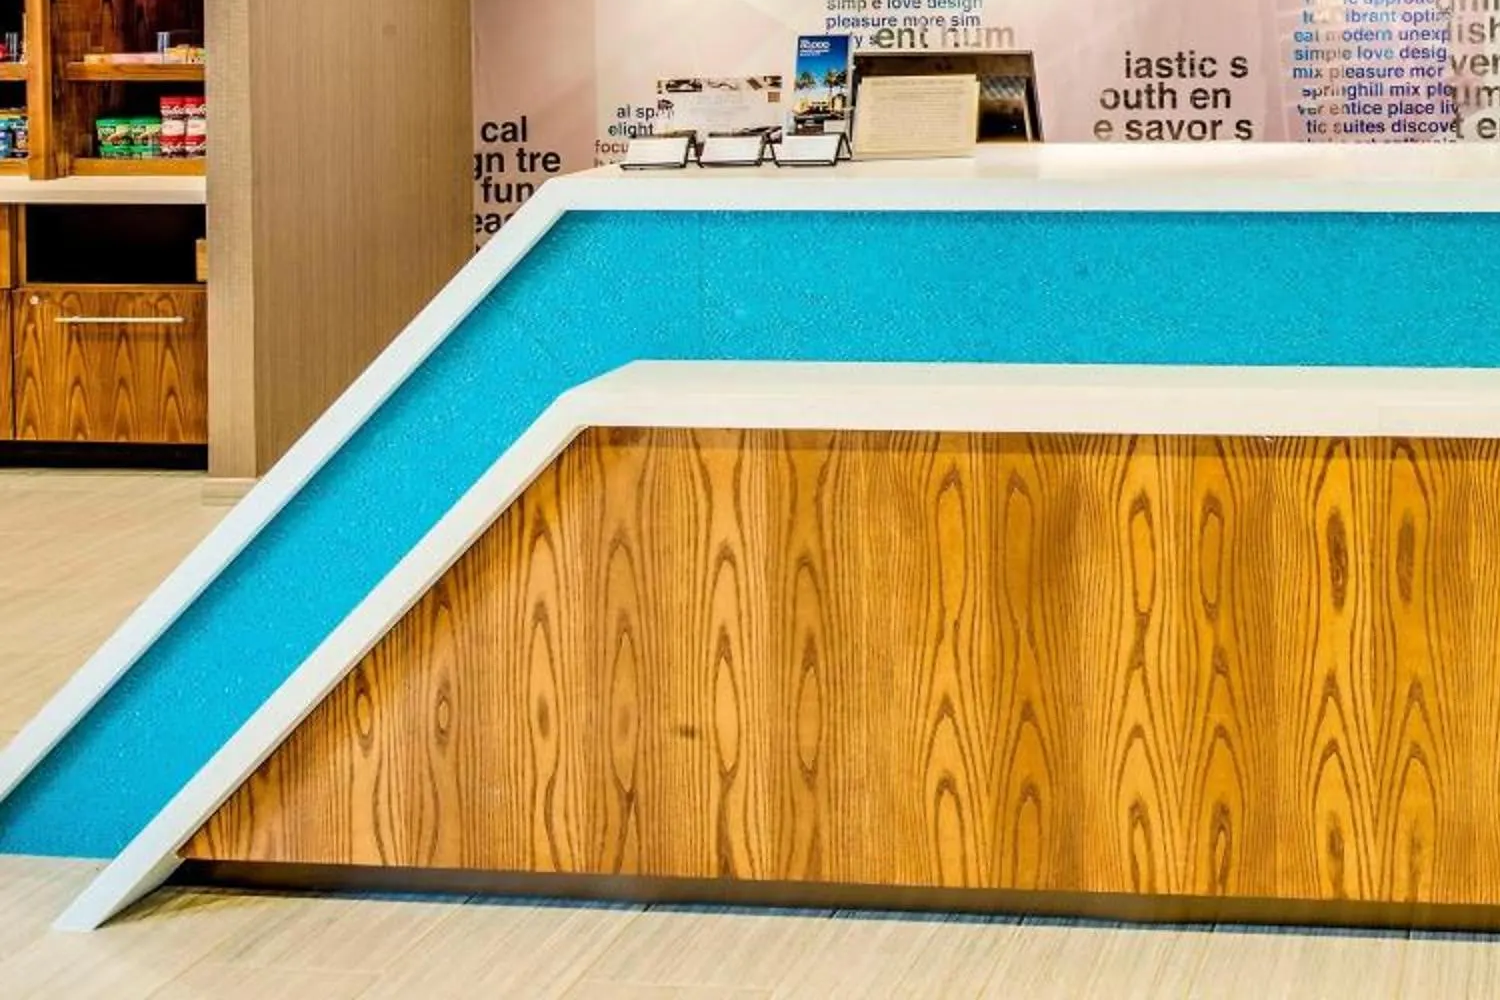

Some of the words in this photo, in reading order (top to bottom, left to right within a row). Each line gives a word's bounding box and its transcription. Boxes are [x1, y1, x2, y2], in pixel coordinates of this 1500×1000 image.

[825, 14, 897, 32] pleasure
[951, 15, 981, 27] sim
[1357, 46, 1395, 60] love
[1125, 50, 1218, 79] iastic
[1230, 56, 1249, 79] s
[1292, 66, 1323, 79] mix
[1329, 65, 1405, 81] pleasure
[1409, 66, 1444, 79] mor
[1100, 82, 1178, 110] outh
[1189, 86, 1232, 110] en
[1389, 83, 1421, 96] mix
[1329, 101, 1388, 115] entice
[1388, 101, 1435, 118] place
[481, 116, 527, 142] cal
[1093, 119, 1113, 141] e
[1125, 119, 1223, 141] savor
[1234, 119, 1254, 141] s
[1334, 119, 1386, 133] suites
[516, 148, 561, 173] tre
[482, 176, 534, 203] fun
